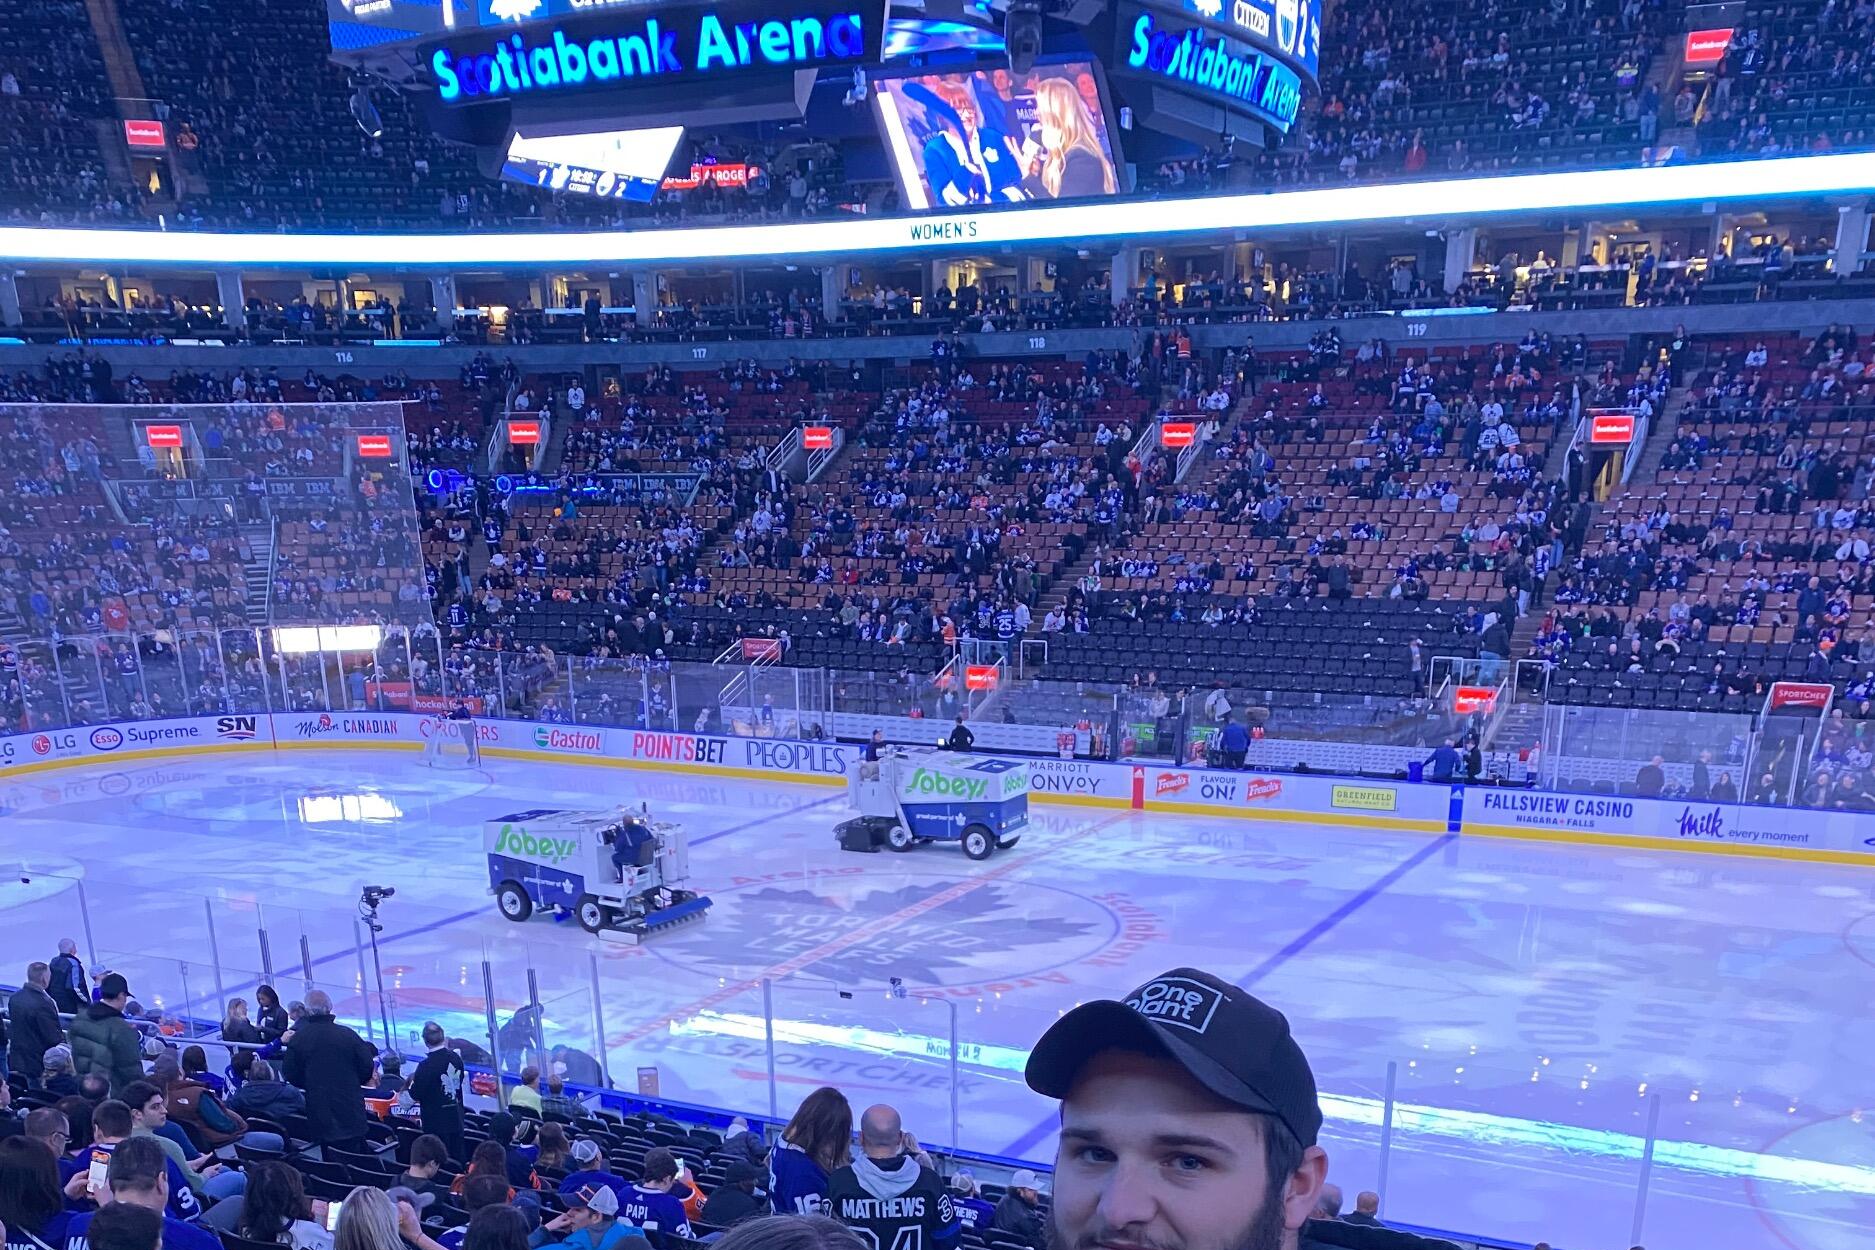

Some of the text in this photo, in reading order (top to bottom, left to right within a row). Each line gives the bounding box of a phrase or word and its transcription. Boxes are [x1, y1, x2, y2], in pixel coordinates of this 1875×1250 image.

[432, 14, 863, 98] Scotiabank Arena
[1129, 15, 1264, 104] Scotiabank
[1260, 66, 1301, 125] Arena
[911, 221, 977, 240] WOMEN'S
[1408, 324, 1427, 336] 119
[1029, 337, 1045, 349] 118
[336, 352, 353, 362] 116
[692, 348, 706, 358] 117
[271, 482, 330, 494] IBM IBM
[217, 717, 256, 732] SN
[343, 720, 398, 734] CANADIAN
[436, 722, 498, 740] RORS
[54, 734, 76, 750] LG
[128, 726, 199, 744] Supreme
[550, 730, 600, 750] Castrol
[0, 742, 14, 757] G
[633, 733, 728, 764] POINTSBET
[746, 741, 846, 774] PEOPLES
[1030, 760, 1090, 774] MARRIOTT
[905, 768, 989, 800] Sobeys
[1032, 774, 1101, 794] ONVOY
[1201, 776, 1237, 784] FLAVOUR
[1202, 784, 1236, 800] ON!
[1336, 790, 1392, 801] GREENFIELD
[1484, 794, 1633, 818] FALLSVIEW CASINO
[1516, 815, 1594, 828] NIAGARA FALLS
[495, 824, 576, 864] Sobeys
[1728, 829, 1809, 843] every moment
[763, 912, 986, 948] TORNTO
[773, 927, 928, 951] MALE
[745, 937, 903, 966] LEFS
[1142, 982, 1204, 1006] One
[177, 1186, 194, 1209] 3
[626, 1203, 648, 1220] PAPI
[842, 1197, 925, 1219] MATTHEWS
